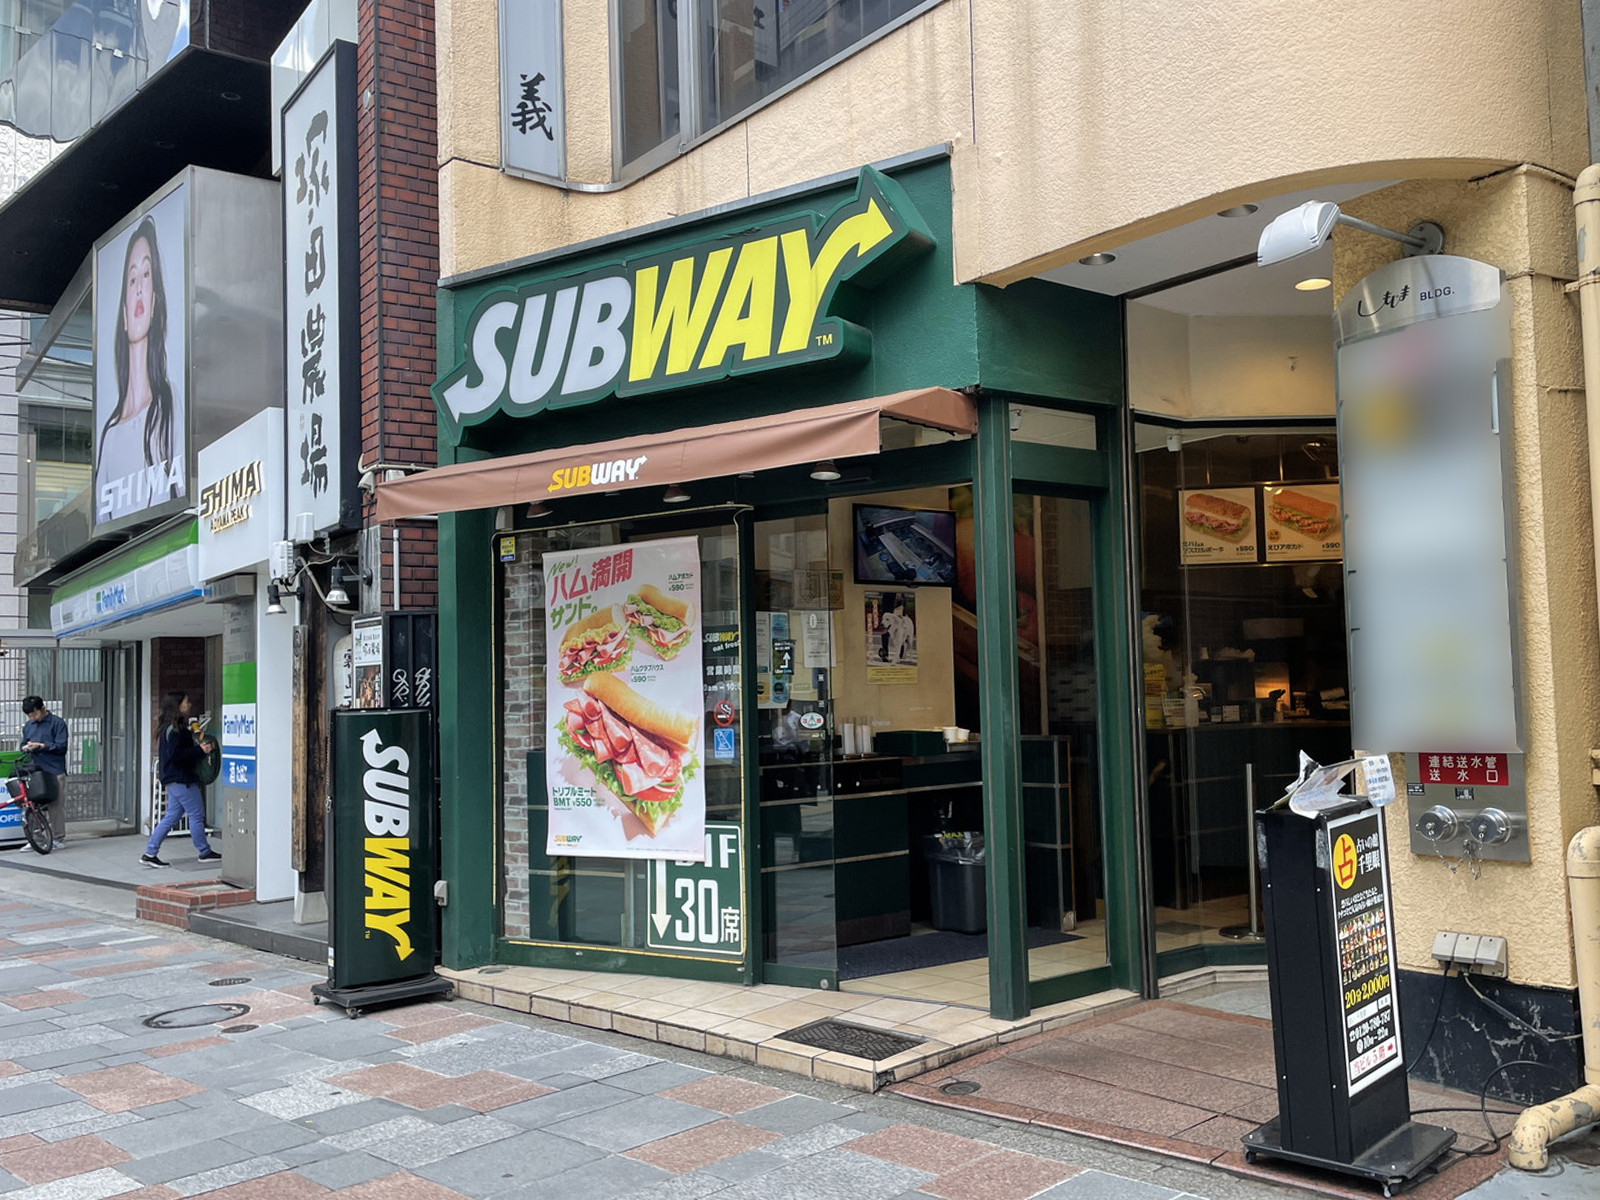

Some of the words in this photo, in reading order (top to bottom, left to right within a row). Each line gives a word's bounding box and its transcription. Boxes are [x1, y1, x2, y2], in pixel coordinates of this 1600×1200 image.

[511, 72, 554, 141] 義
[442, 198, 894, 424] SUBWAY
[1420, 286, 1455, 302] BLDG.
[98, 454, 184, 516] SHIMA
[199, 459, 263, 519] SHIMA
[547, 455, 648, 493] SUBWAY
[548, 554, 580, 577] New!
[550, 548, 634, 605] ハム満開
[703, 631, 740, 643] SUBWAY
[725, 641, 739, 650] fres
[223, 714, 255, 738] FamilyMart
[1428, 755, 1498, 769] 連結送水管
[552, 786, 597, 797] トリプルミート
[553, 797, 571, 807] BMT
[360, 727, 415, 962] SUBWAY
[675, 834, 737, 868] 1F
[1338, 837, 1353, 886] 占
